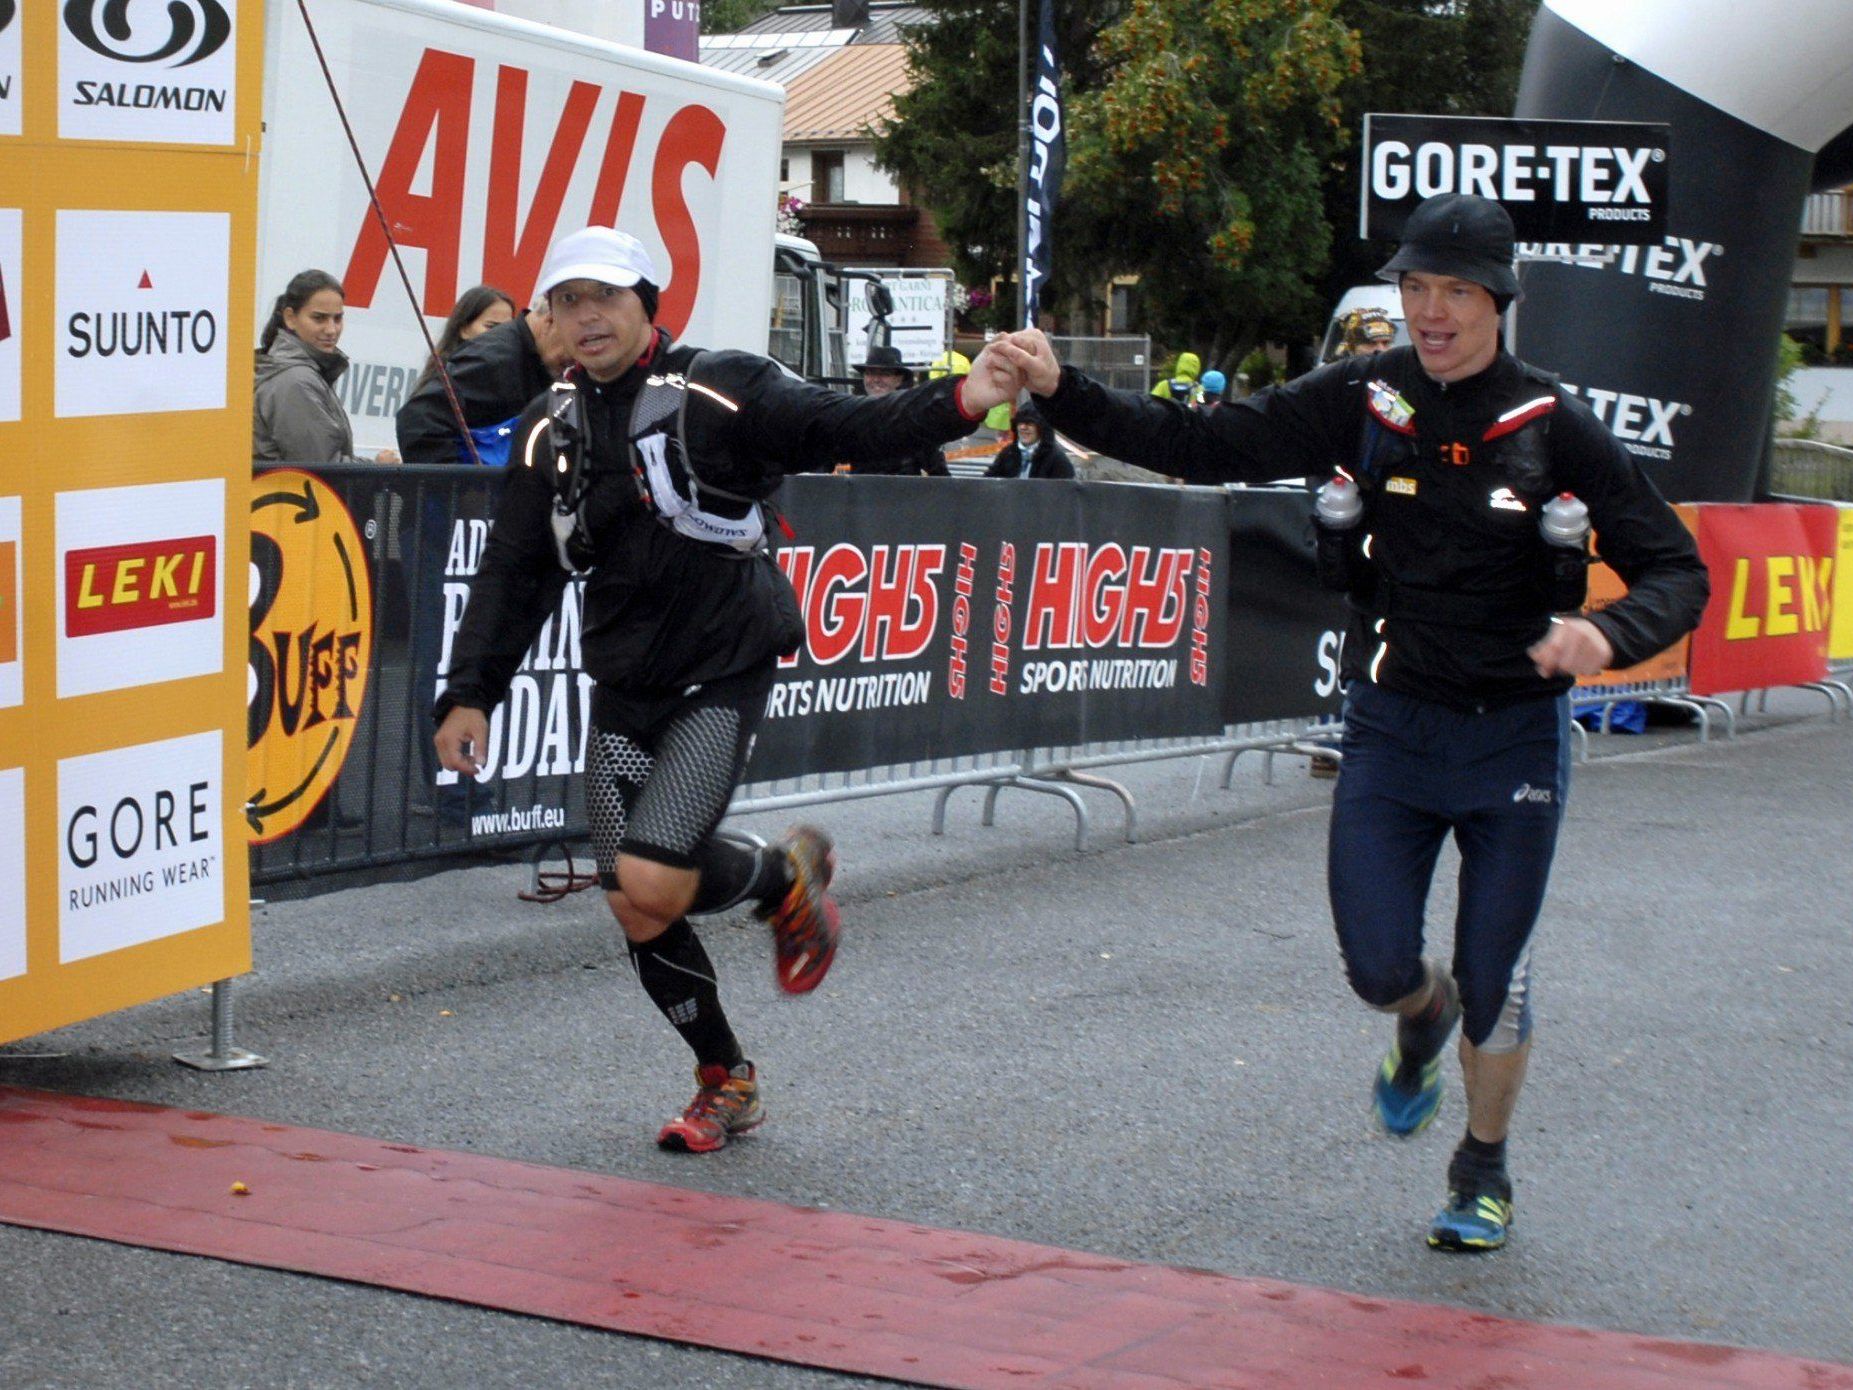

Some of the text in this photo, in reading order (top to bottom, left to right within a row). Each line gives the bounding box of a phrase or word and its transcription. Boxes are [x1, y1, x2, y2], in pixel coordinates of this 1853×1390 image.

[73, 80, 226, 113] SALOMON
[342, 47, 727, 344] AVIS
[1588, 207, 1651, 221] PRODUCTS
[68, 310, 216, 358] SUUNTO
[77, 551, 206, 610] LEKI
[776, 542, 946, 669] IGH5
[1022, 541, 1195, 650] HIGH5
[948, 542, 978, 700] HIGH5
[989, 541, 1016, 696] HIGH5
[814, 670, 931, 713] NUTRITION
[1089, 658, 1178, 689] NUTRITION
[67, 781, 209, 869] GORE
[472, 804, 564, 836] www.buff.eu
[69, 858, 210, 911] RUNNING WEAR
